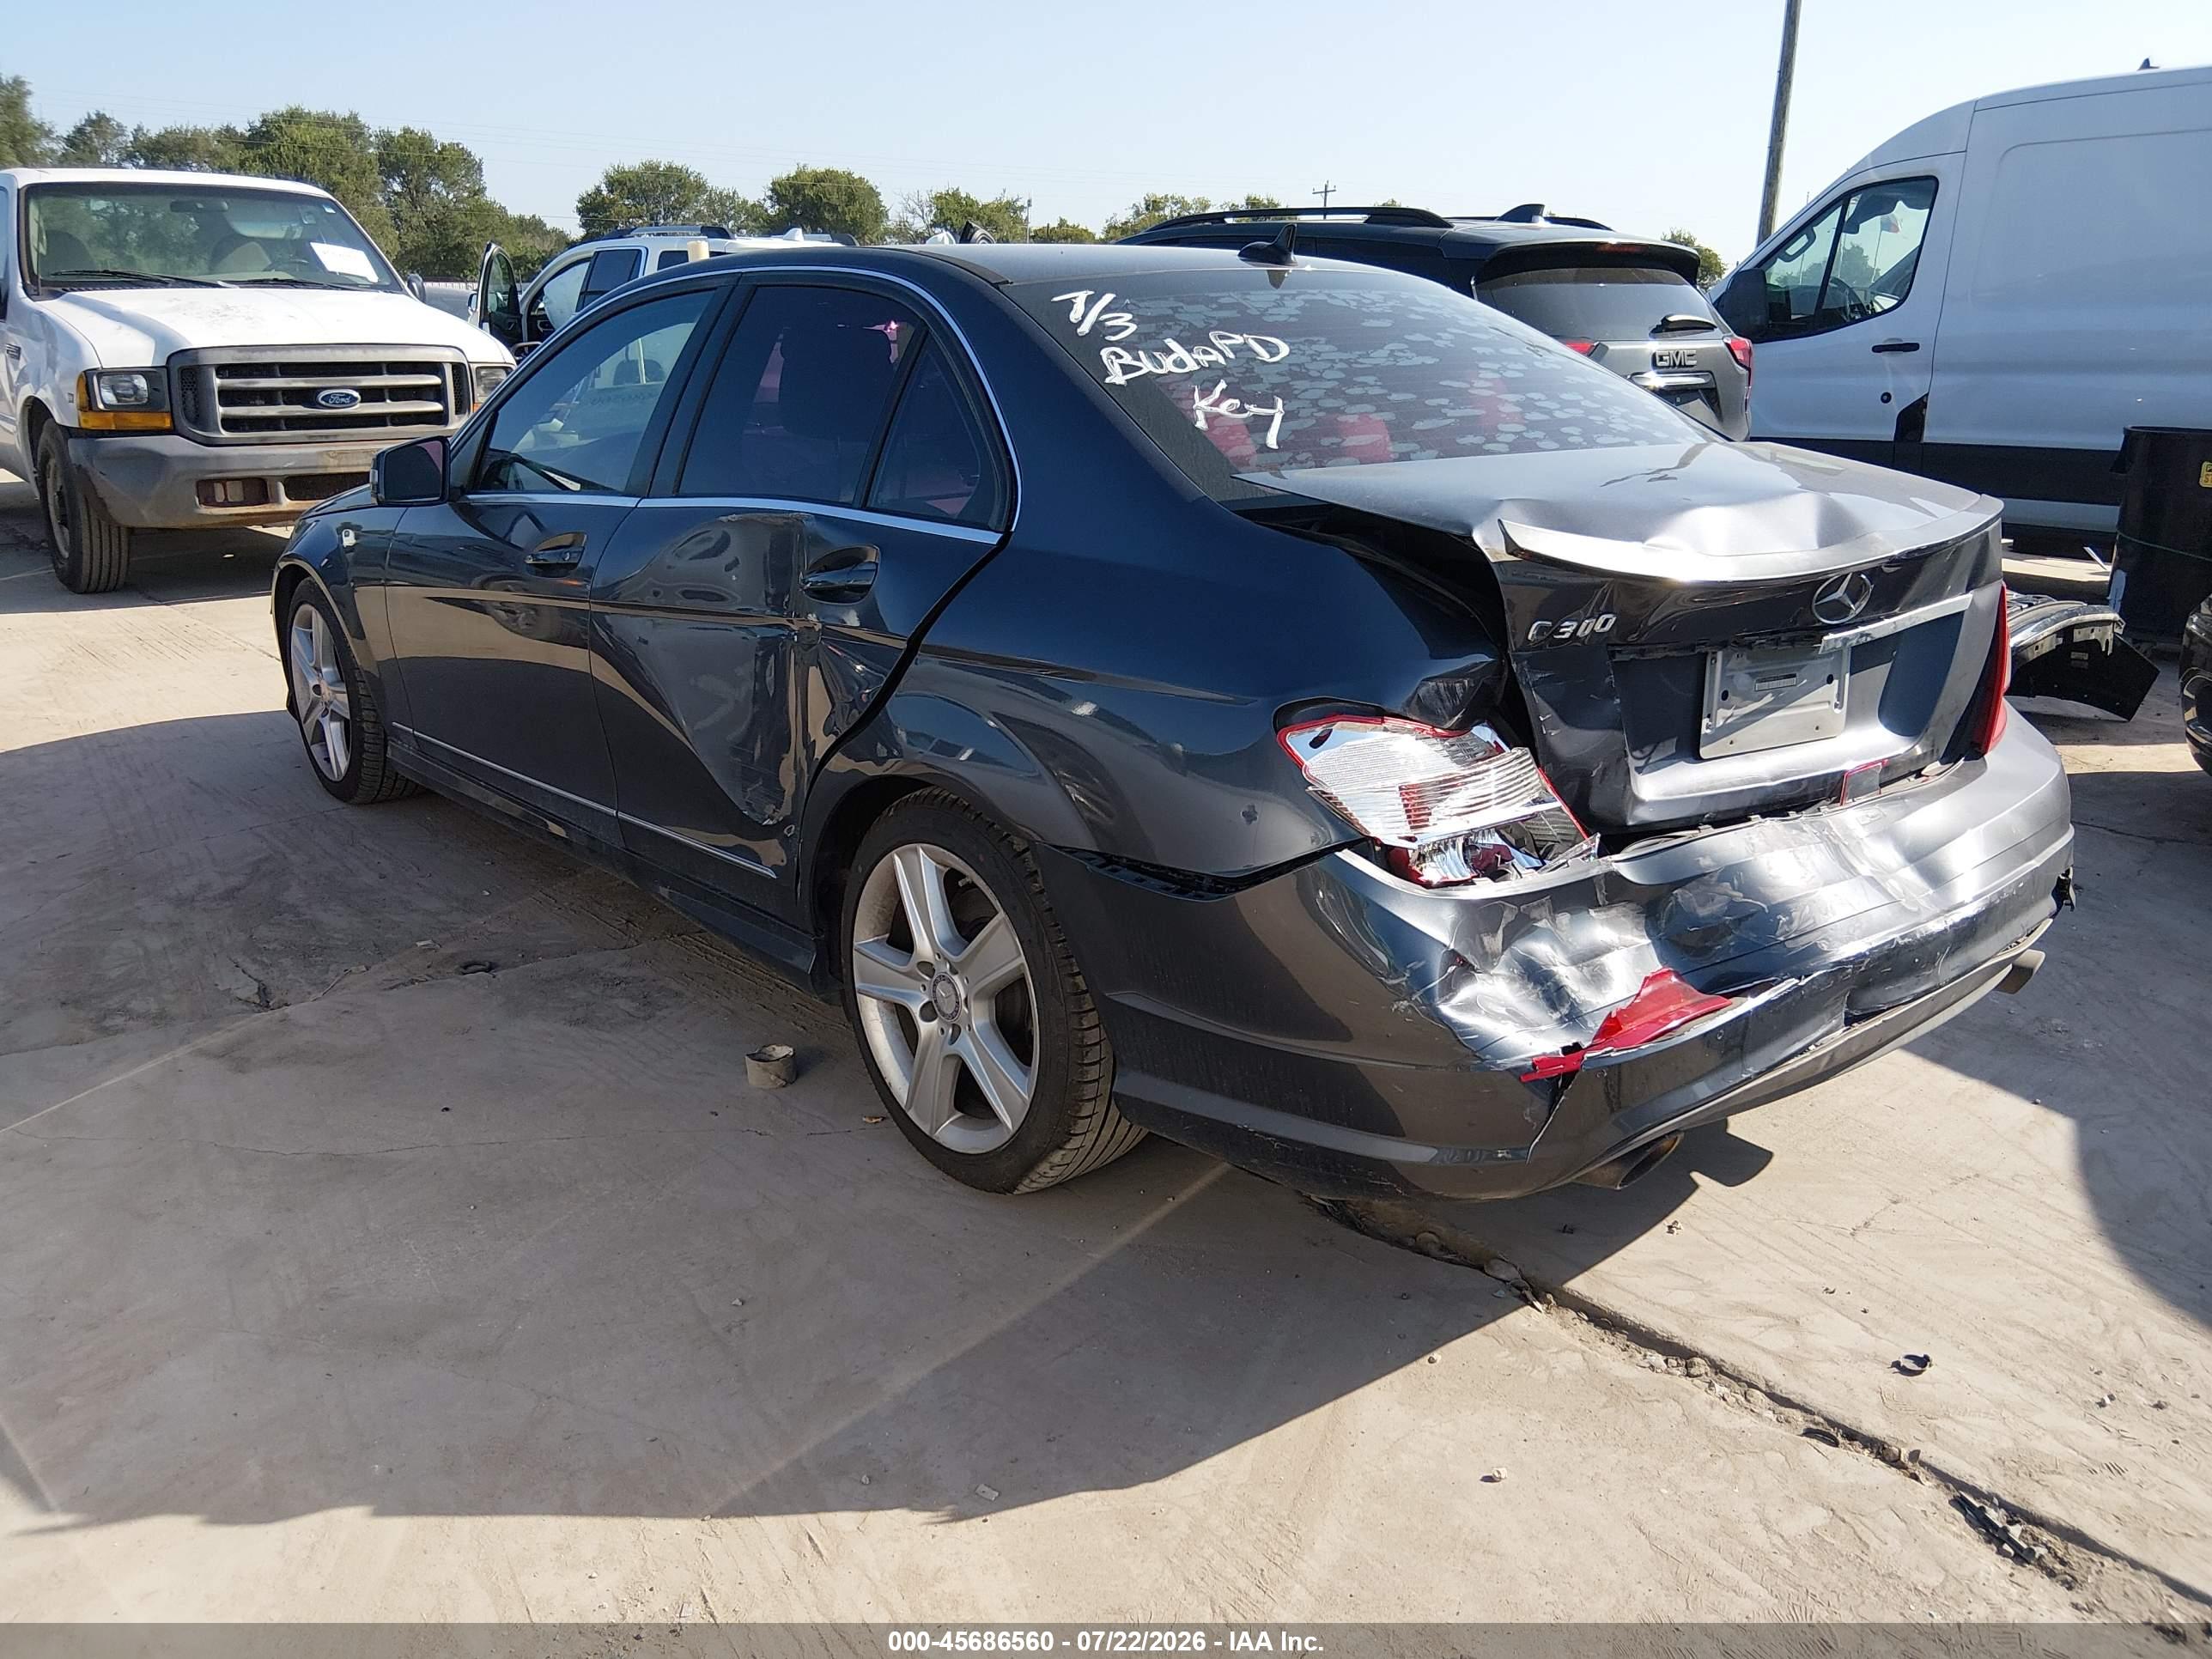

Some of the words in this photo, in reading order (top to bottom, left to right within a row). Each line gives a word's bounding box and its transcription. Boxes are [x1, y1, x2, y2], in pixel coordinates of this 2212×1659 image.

[1051, 289, 1138, 341] 7/3
[1655, 349, 1698, 367] GMC
[328, 393, 351, 404] Ford
[1553, 613, 1617, 639] 300
